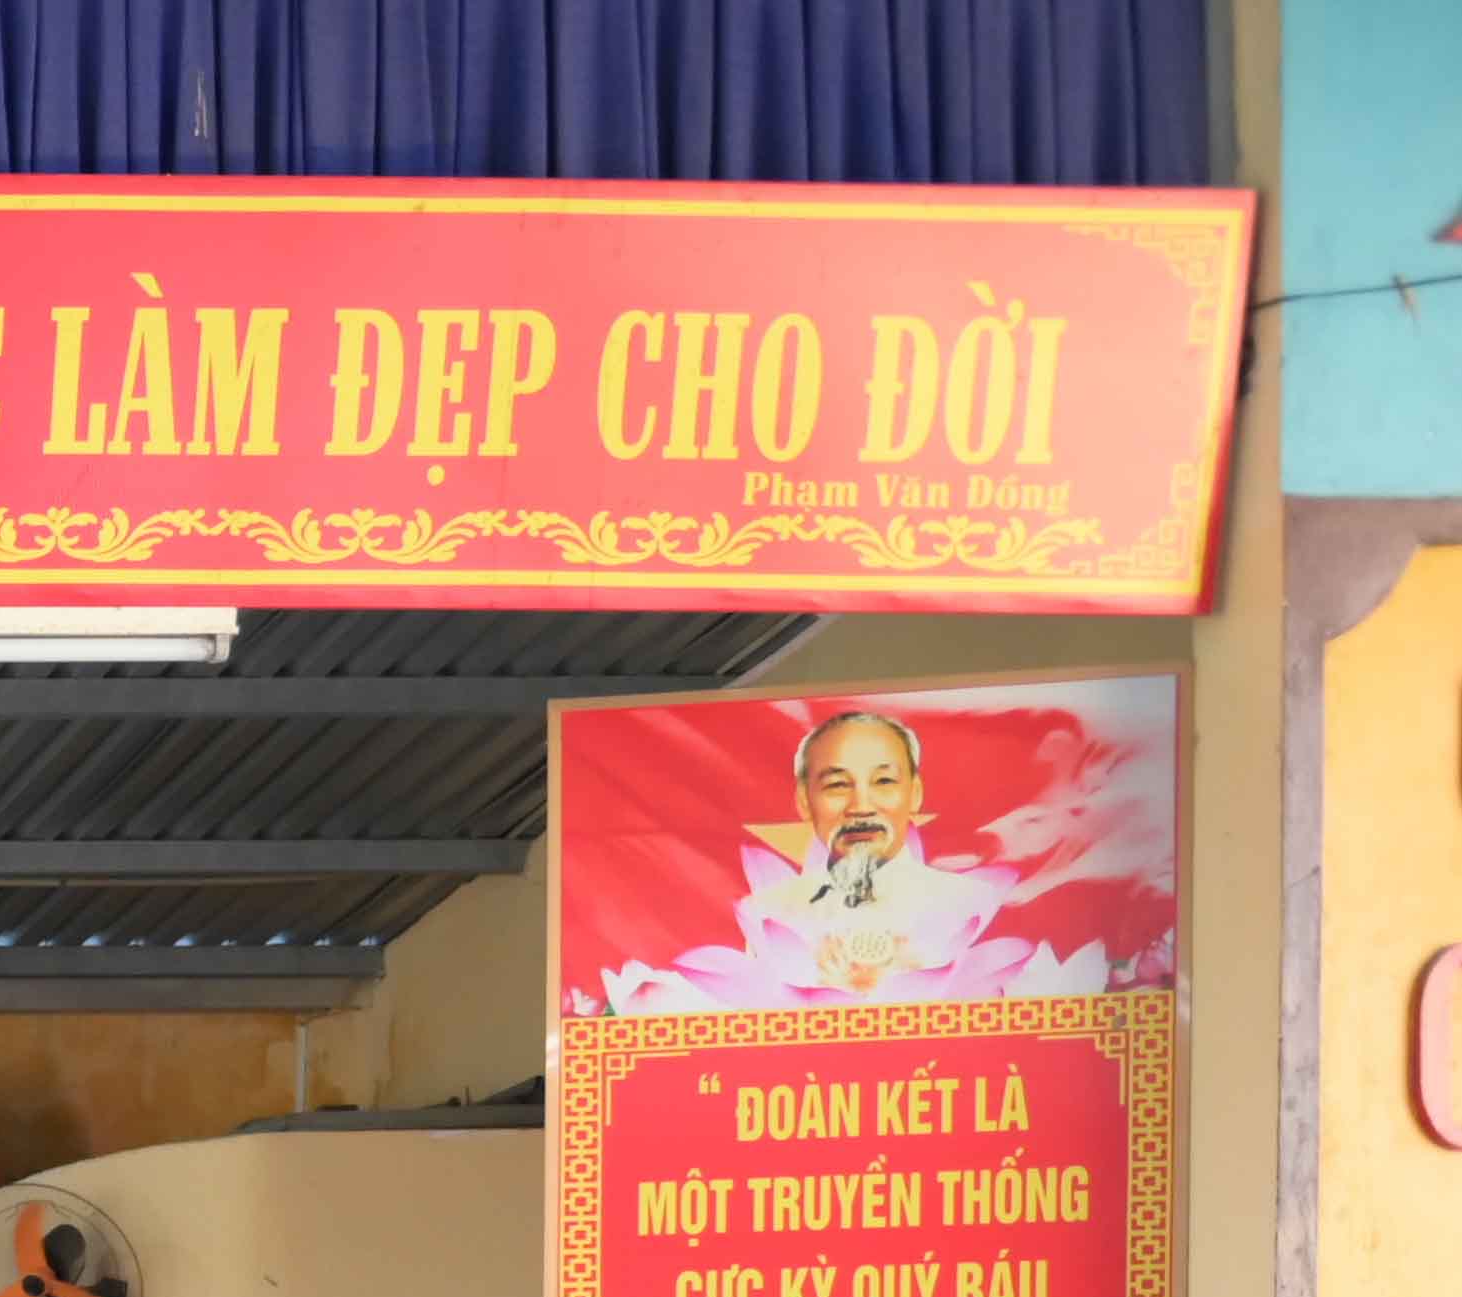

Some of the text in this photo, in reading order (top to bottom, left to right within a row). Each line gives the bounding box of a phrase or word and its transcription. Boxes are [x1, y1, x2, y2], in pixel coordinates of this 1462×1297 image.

[43, 273, 289, 455] LÀM
[325, 309, 556, 485] ĐẸP
[598, 310, 823, 461] CHO
[860, 282, 1068, 464] ĐỜI
[743, 471, 859, 512] Phạm
[877, 474, 952, 509] Văn
[736, 1073, 860, 1141] ĐOÀN
[877, 1061, 959, 1136] KẾT
[976, 1064, 1028, 1132] LÀ
